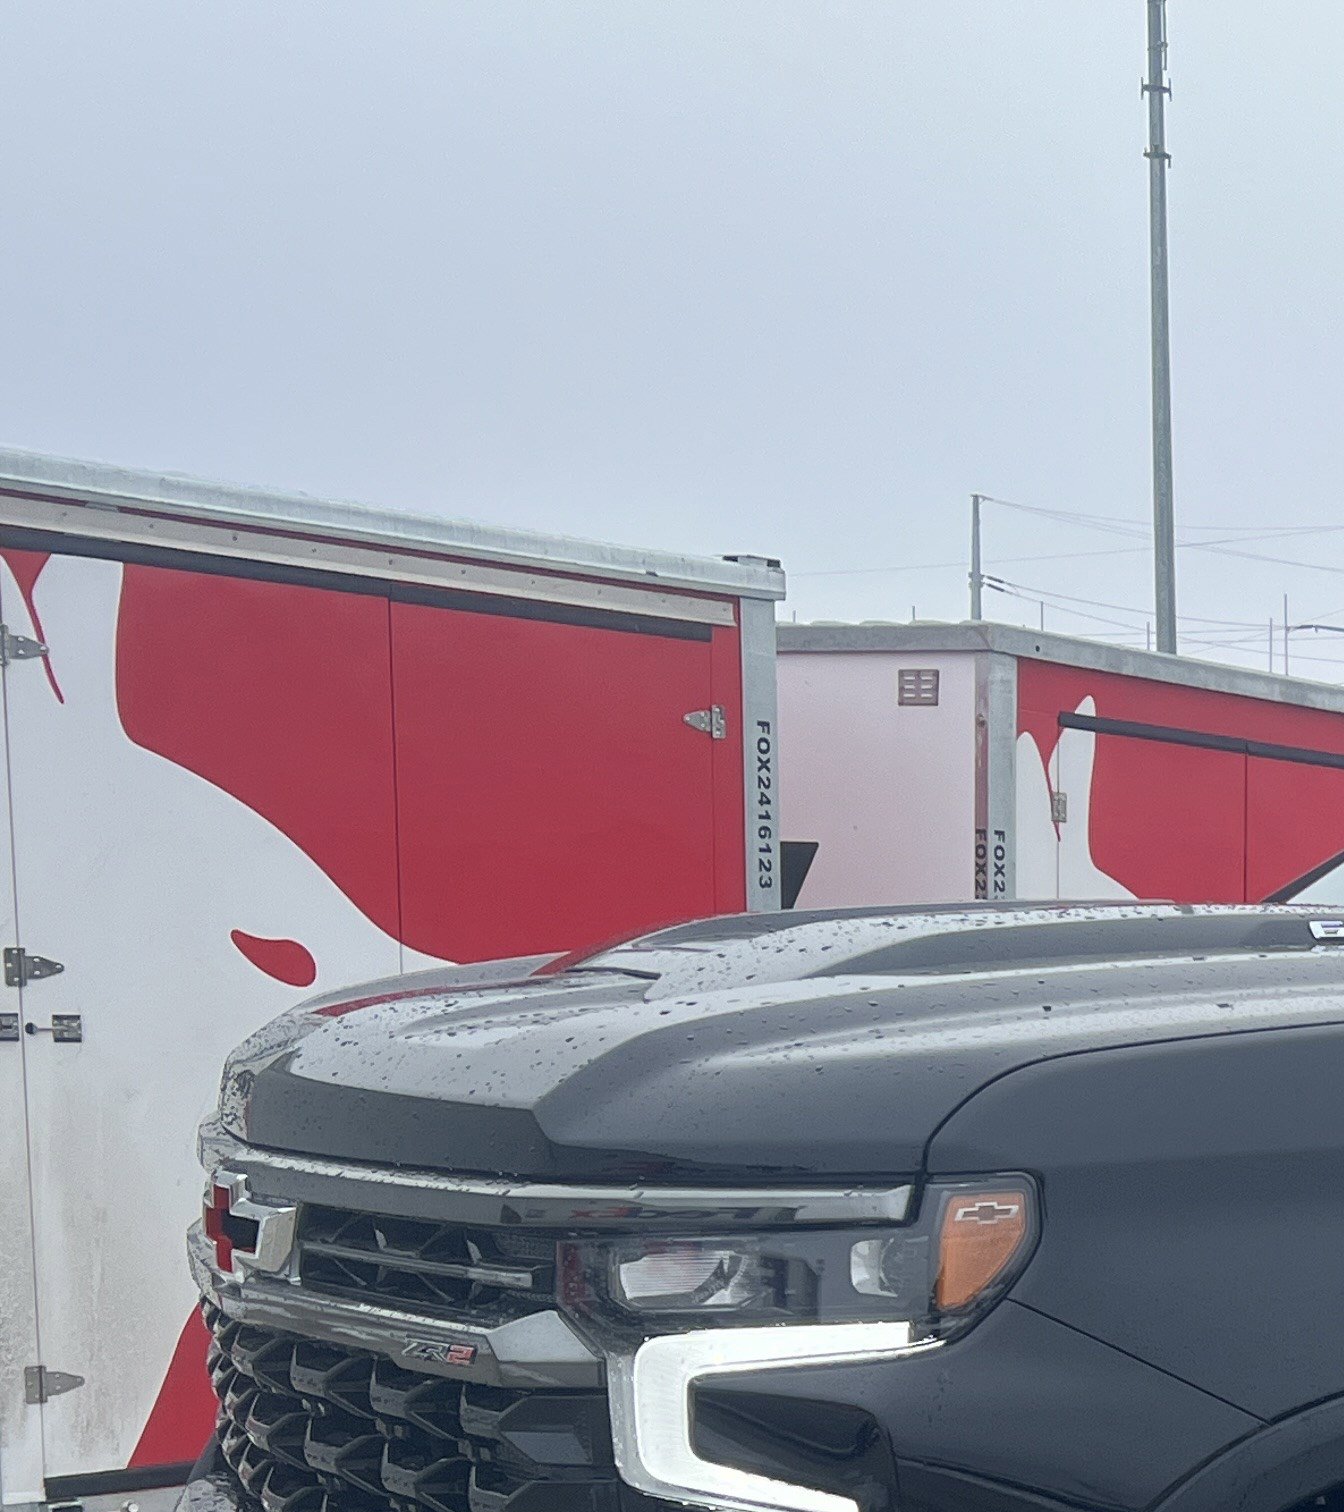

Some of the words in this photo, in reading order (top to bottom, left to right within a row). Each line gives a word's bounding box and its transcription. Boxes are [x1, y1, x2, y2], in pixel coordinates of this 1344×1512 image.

[757, 720, 773, 889] FOX2416123
[975, 828, 987, 899] FOX2
[994, 829, 1006, 899] FOX2
[402, 1338, 476, 1365] ZR2
